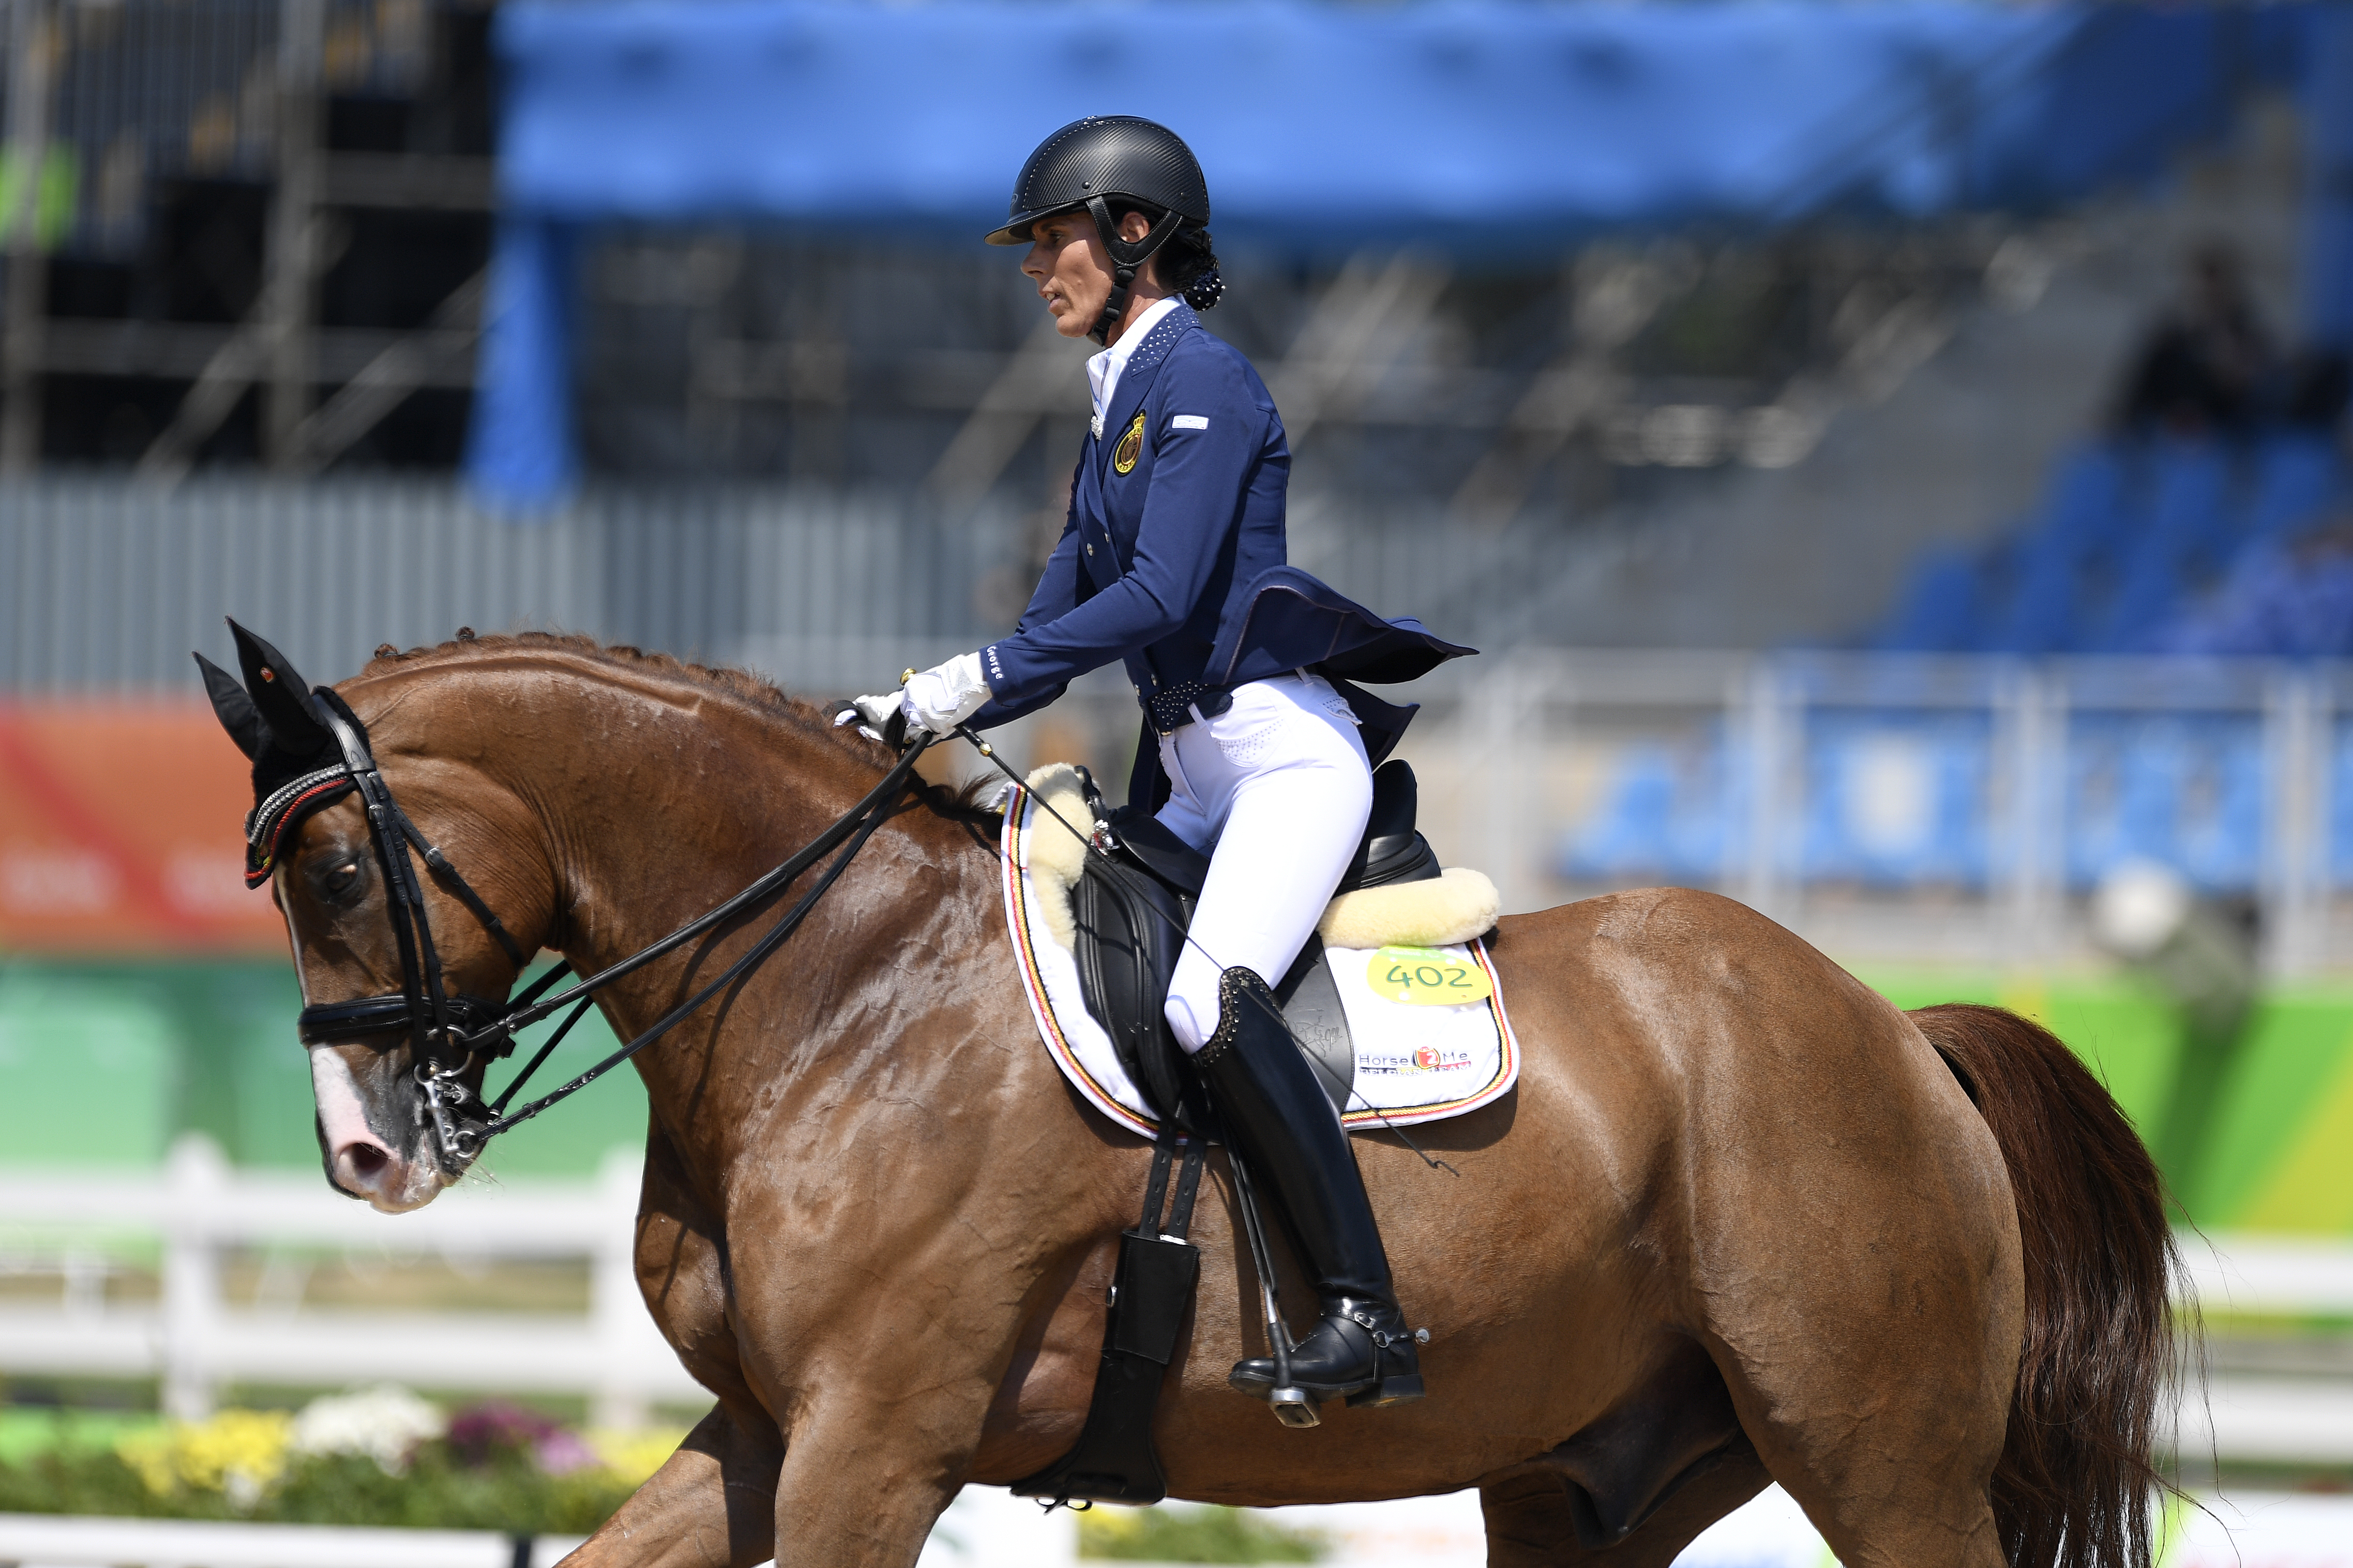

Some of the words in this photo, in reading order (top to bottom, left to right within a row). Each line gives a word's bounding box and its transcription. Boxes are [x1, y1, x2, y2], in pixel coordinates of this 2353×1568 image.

[987, 646, 1003, 679] George
[1386, 965, 1473, 988] 402
[1359, 1055, 1409, 1065] Horse
[1426, 1053, 1437, 1064] 2
[1443, 1052, 1468, 1062] Me
[1360, 1068, 1422, 1076] BELGIAN
[1428, 1063, 1471, 1073] TEAM
